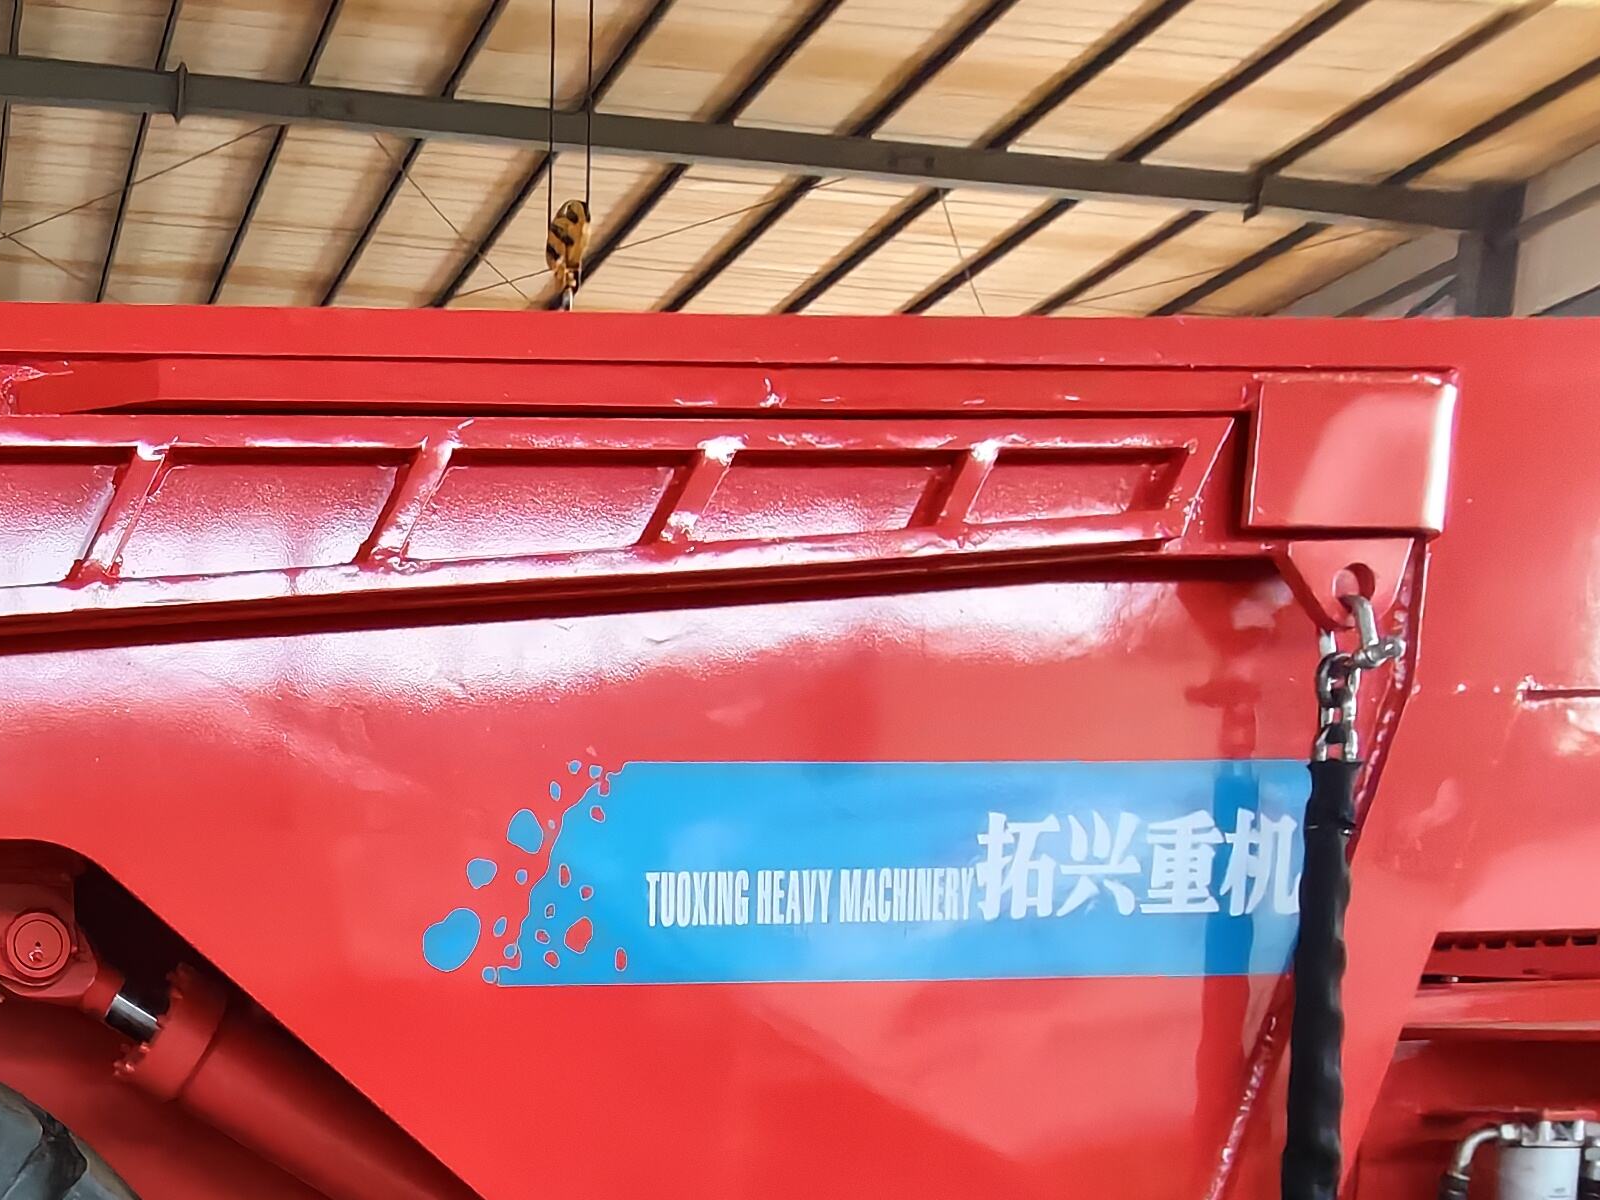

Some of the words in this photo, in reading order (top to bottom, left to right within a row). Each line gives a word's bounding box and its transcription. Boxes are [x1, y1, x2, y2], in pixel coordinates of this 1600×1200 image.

[645, 870, 749, 927] TUOXING
[756, 869, 833, 925] HEAVY
[839, 867, 975, 923] MACHINERY
[976, 807, 1300, 921] 拓兴重机
